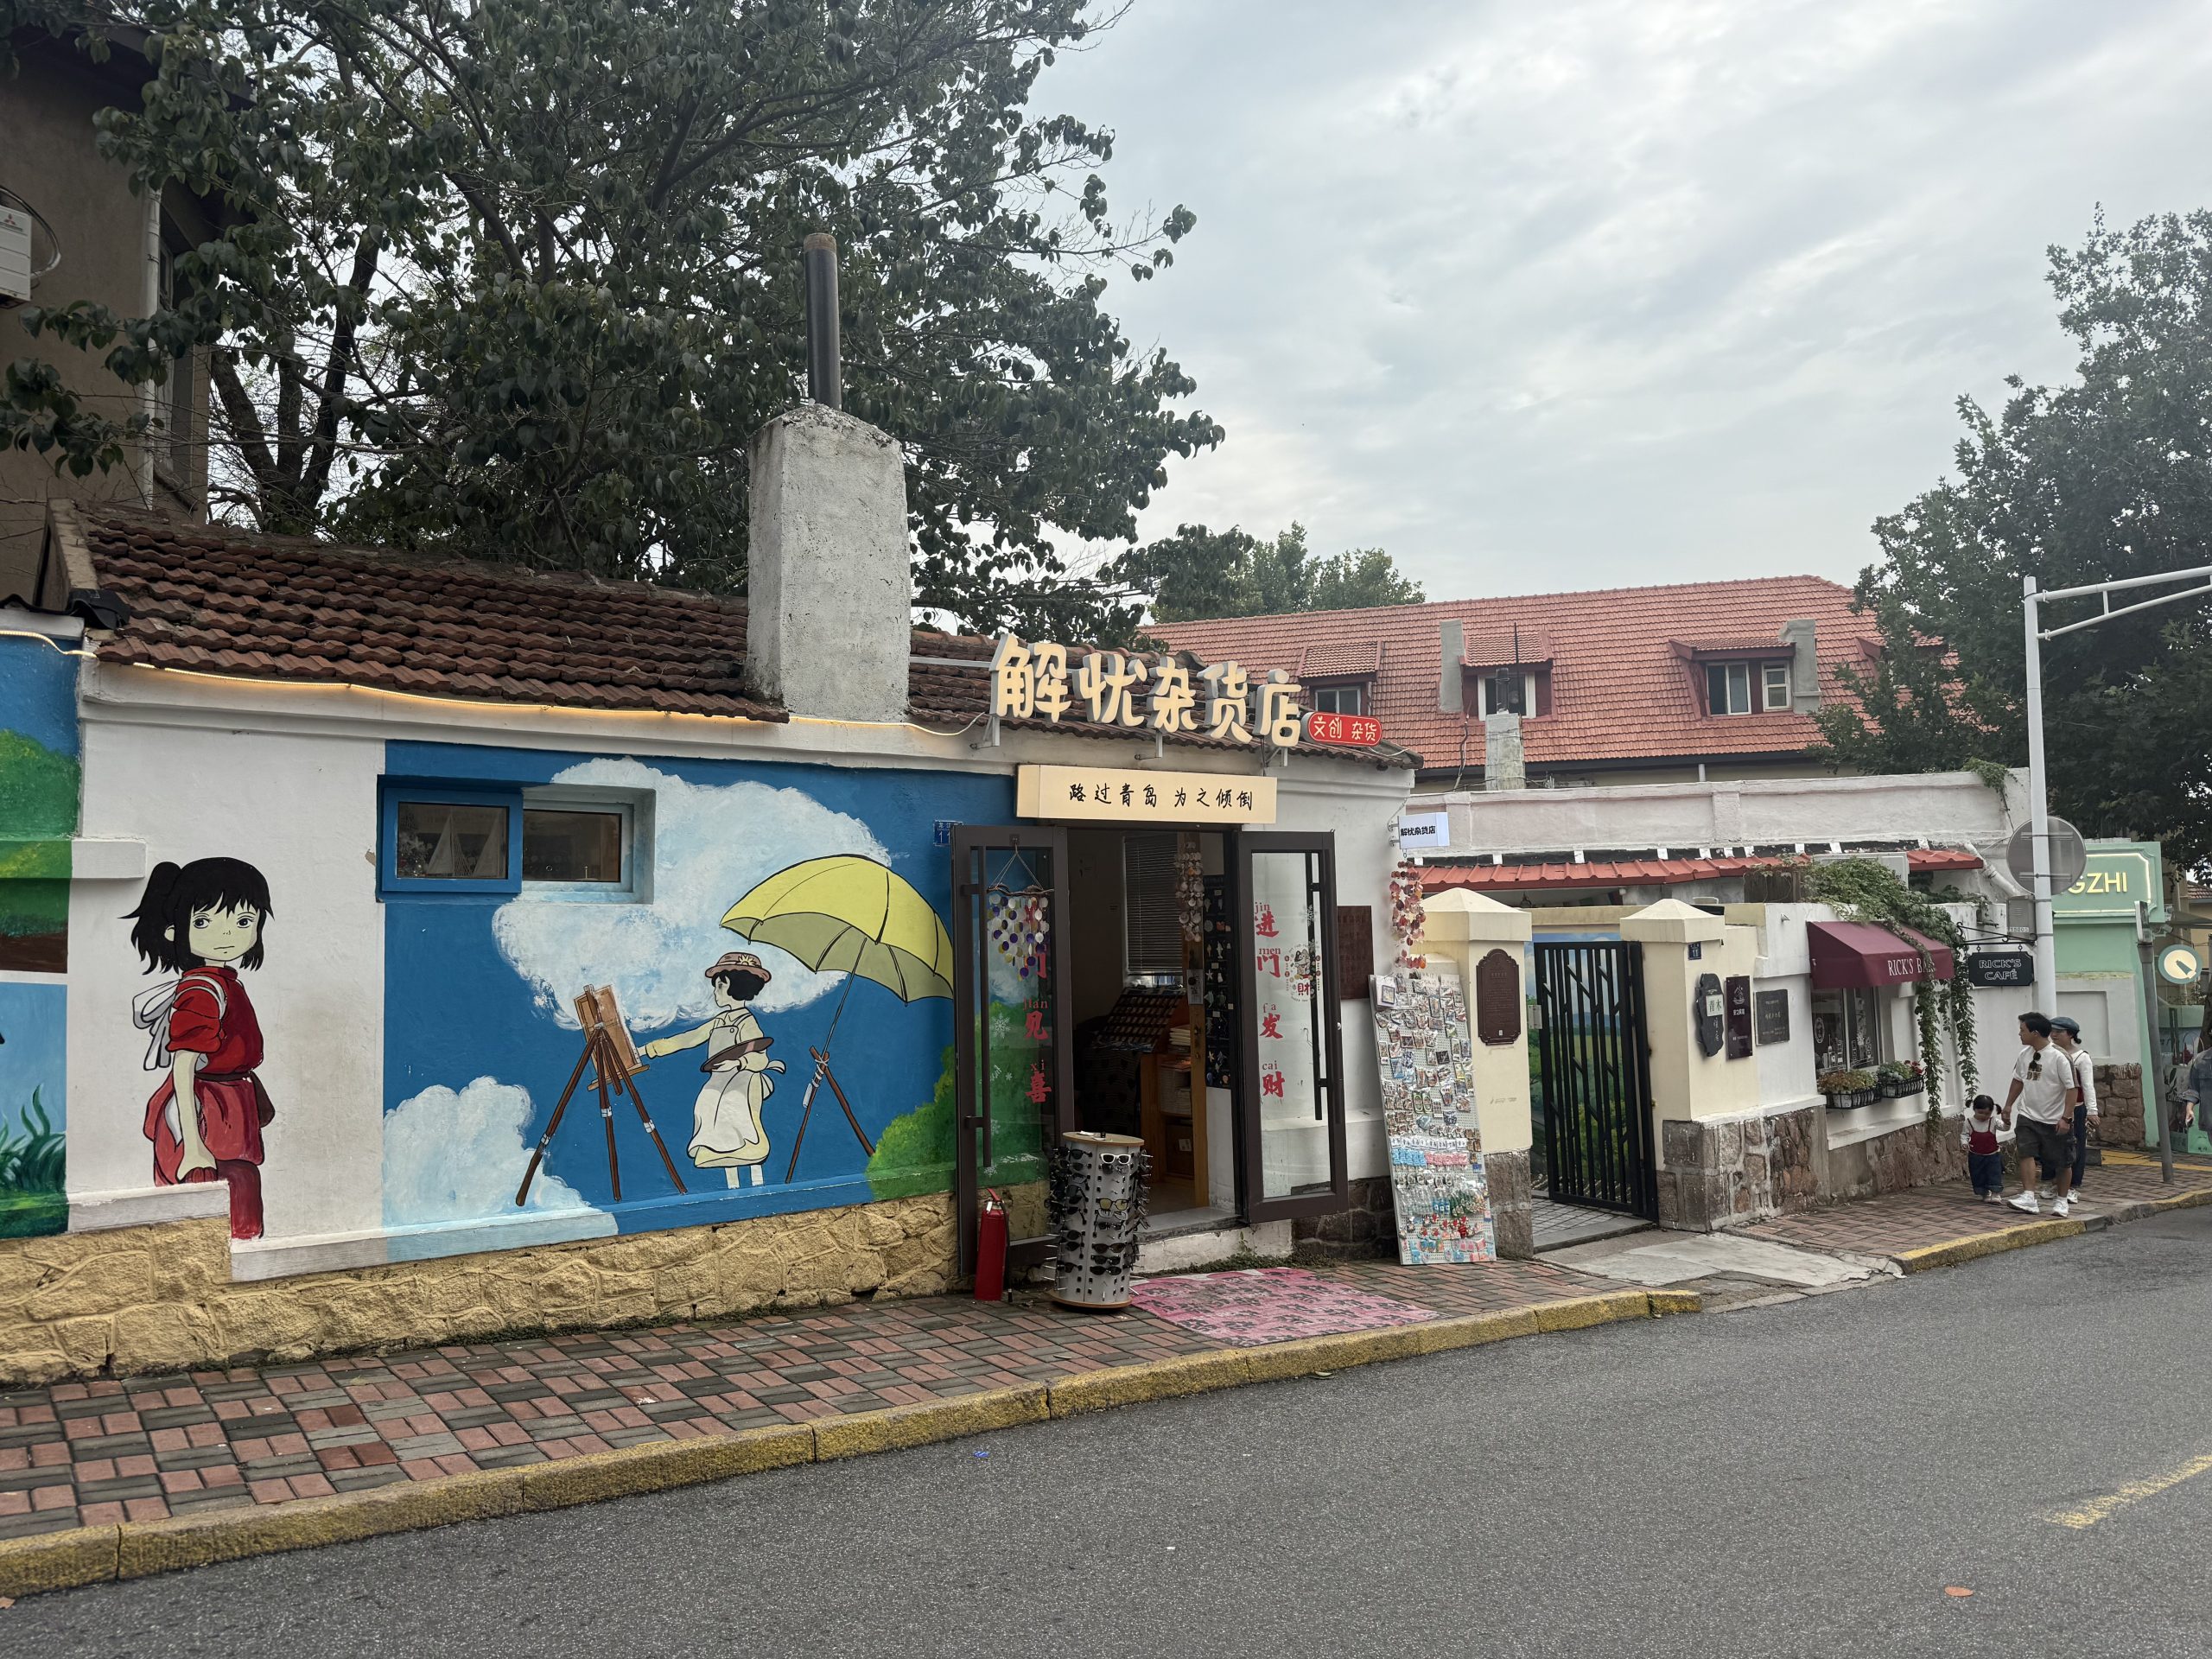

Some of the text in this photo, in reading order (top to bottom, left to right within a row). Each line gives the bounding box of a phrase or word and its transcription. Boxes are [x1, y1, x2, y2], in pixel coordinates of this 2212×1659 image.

[988, 633, 1302, 747] 解忧杂货店
[1313, 715, 1377, 741] 文创 杂货
[1069, 782, 1253, 811] 路过青岛 为之倾倒
[1400, 825, 1436, 836] 解忧杂货店
[2066, 871, 2128, 895] GZHI
[1254, 901, 1271, 914] jin
[1254, 910, 1280, 938] 进
[1256, 953, 1281, 978] 门
[1887, 958, 1914, 976] RICK'S
[1979, 958, 2022, 969] RICK'S
[1984, 968, 2018, 981] CAFÉ
[1024, 1010, 1049, 1040] 见
[1259, 1013, 1283, 1039] 发
[1262, 1060, 1278, 1071] cai
[1025, 1071, 1052, 1103] 喜
[1262, 1071, 1285, 1098] 财
